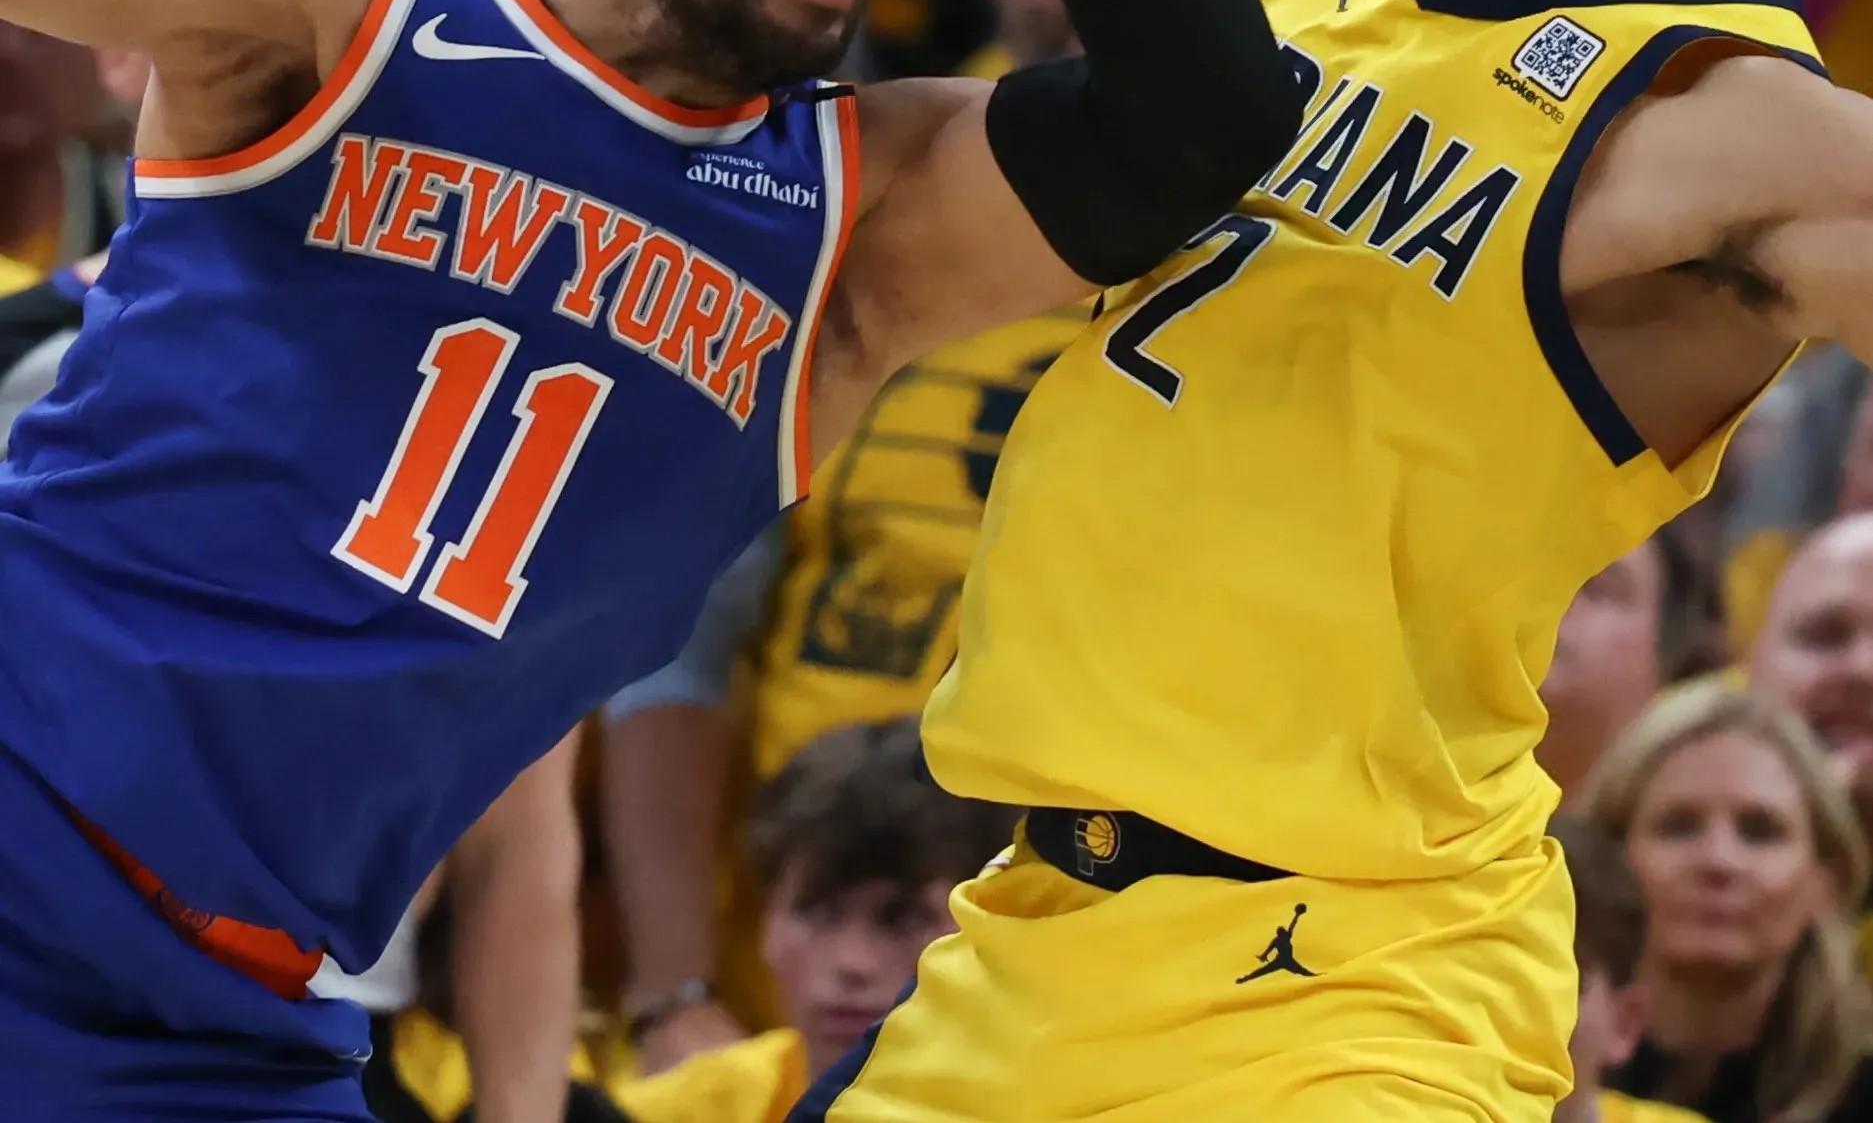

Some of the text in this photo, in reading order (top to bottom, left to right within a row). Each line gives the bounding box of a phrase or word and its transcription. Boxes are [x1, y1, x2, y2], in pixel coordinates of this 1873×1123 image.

[685, 162, 821, 210] abu dhabi
[1492, 67, 1566, 125] spokenote
[304, 132, 793, 433] NEW YORK
[1104, 211, 1278, 411] 2
[329, 316, 616, 641] 11
